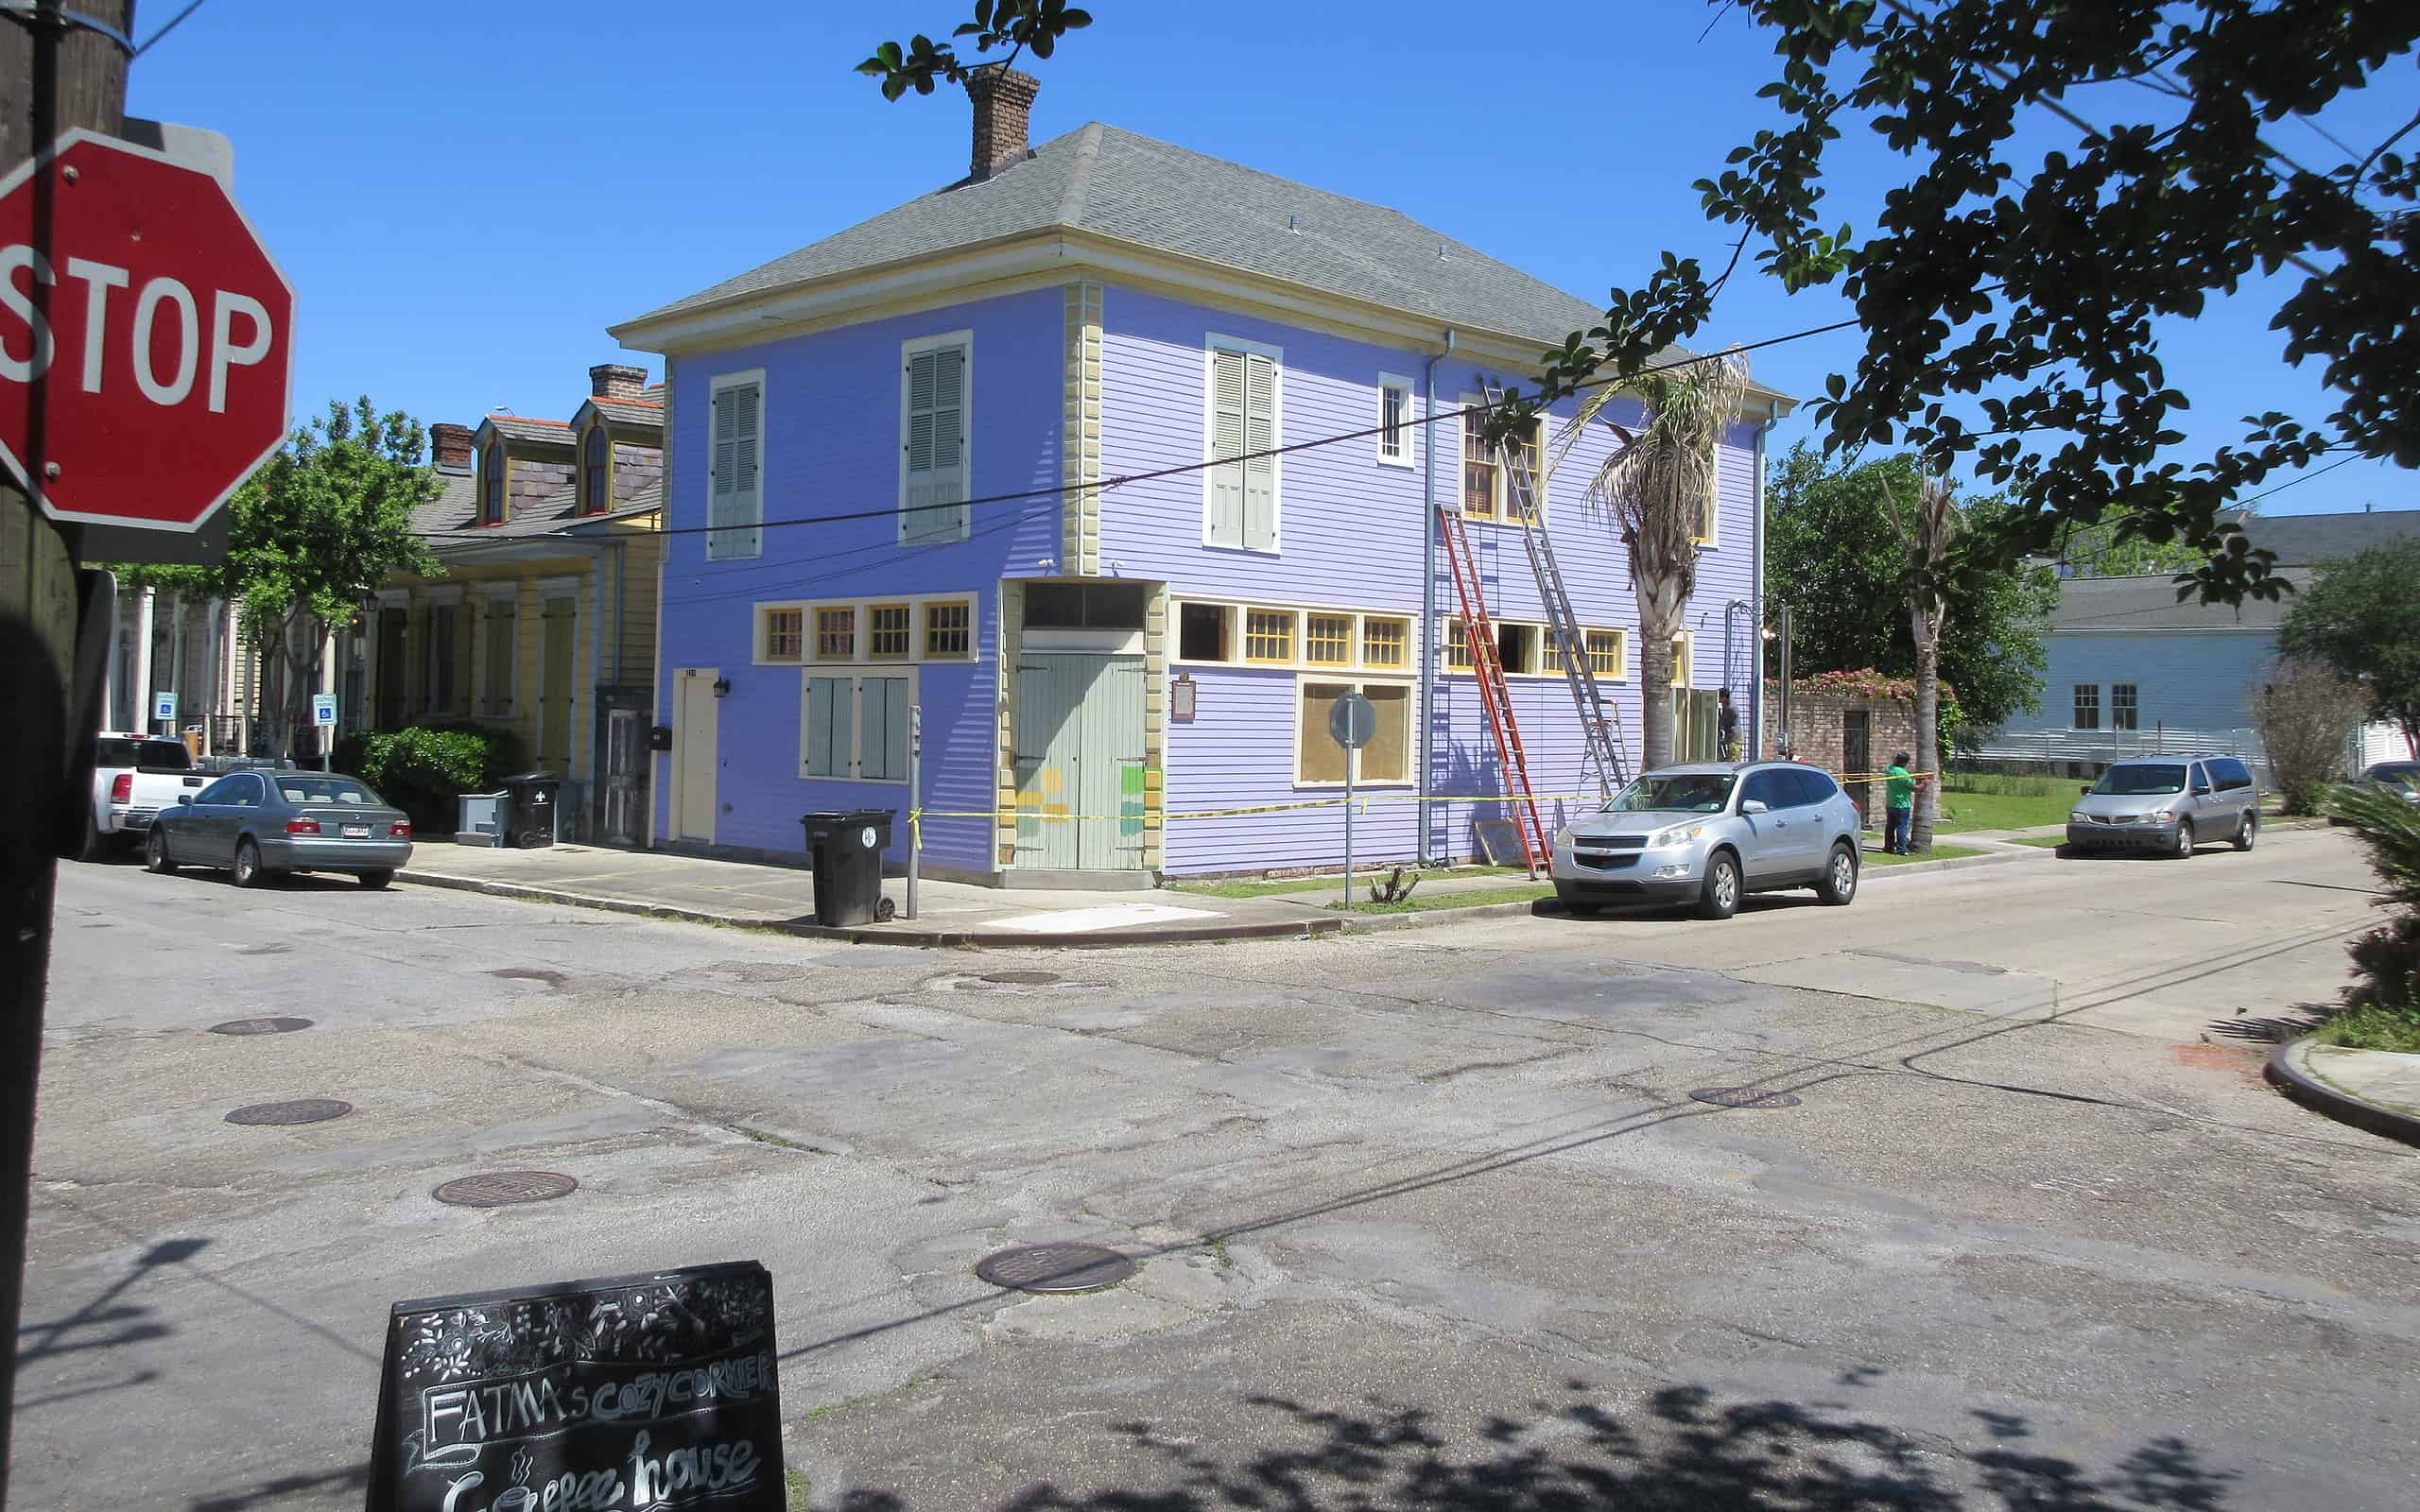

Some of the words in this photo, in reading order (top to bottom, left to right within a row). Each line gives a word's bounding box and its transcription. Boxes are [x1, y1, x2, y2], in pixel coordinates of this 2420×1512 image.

[0, 244, 273, 414] STOP
[592, 1373, 667, 1418] COZY
[667, 1352, 777, 1401] CORNER
[628, 1429, 761, 1506] house
